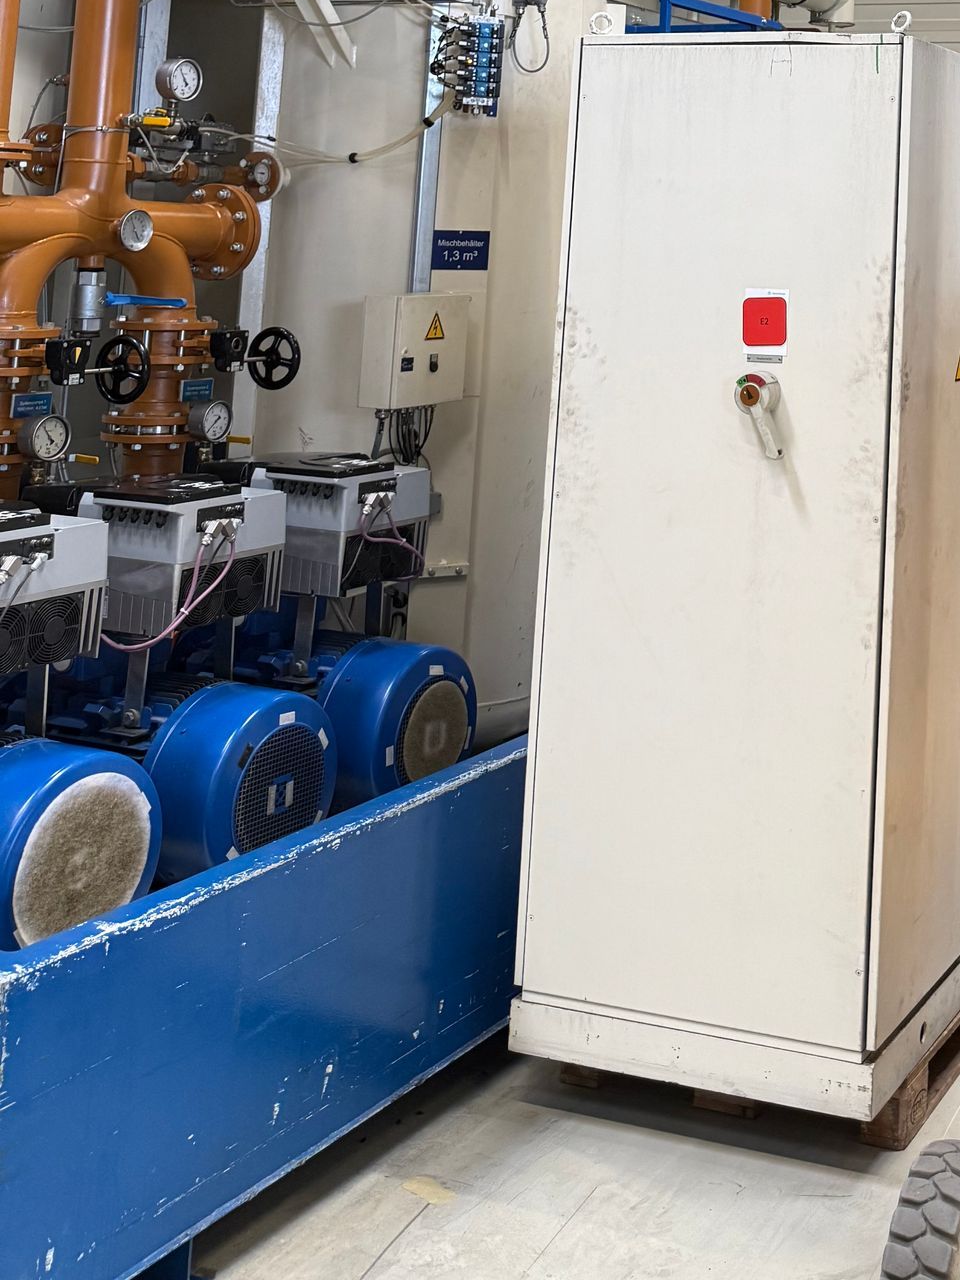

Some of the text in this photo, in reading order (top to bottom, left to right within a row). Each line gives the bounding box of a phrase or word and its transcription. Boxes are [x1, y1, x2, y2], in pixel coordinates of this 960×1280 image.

[437, 239, 485, 247] Mischbehälter
[443, 250, 479, 262] 1,3 m³
[760, 317, 769, 326] E2
